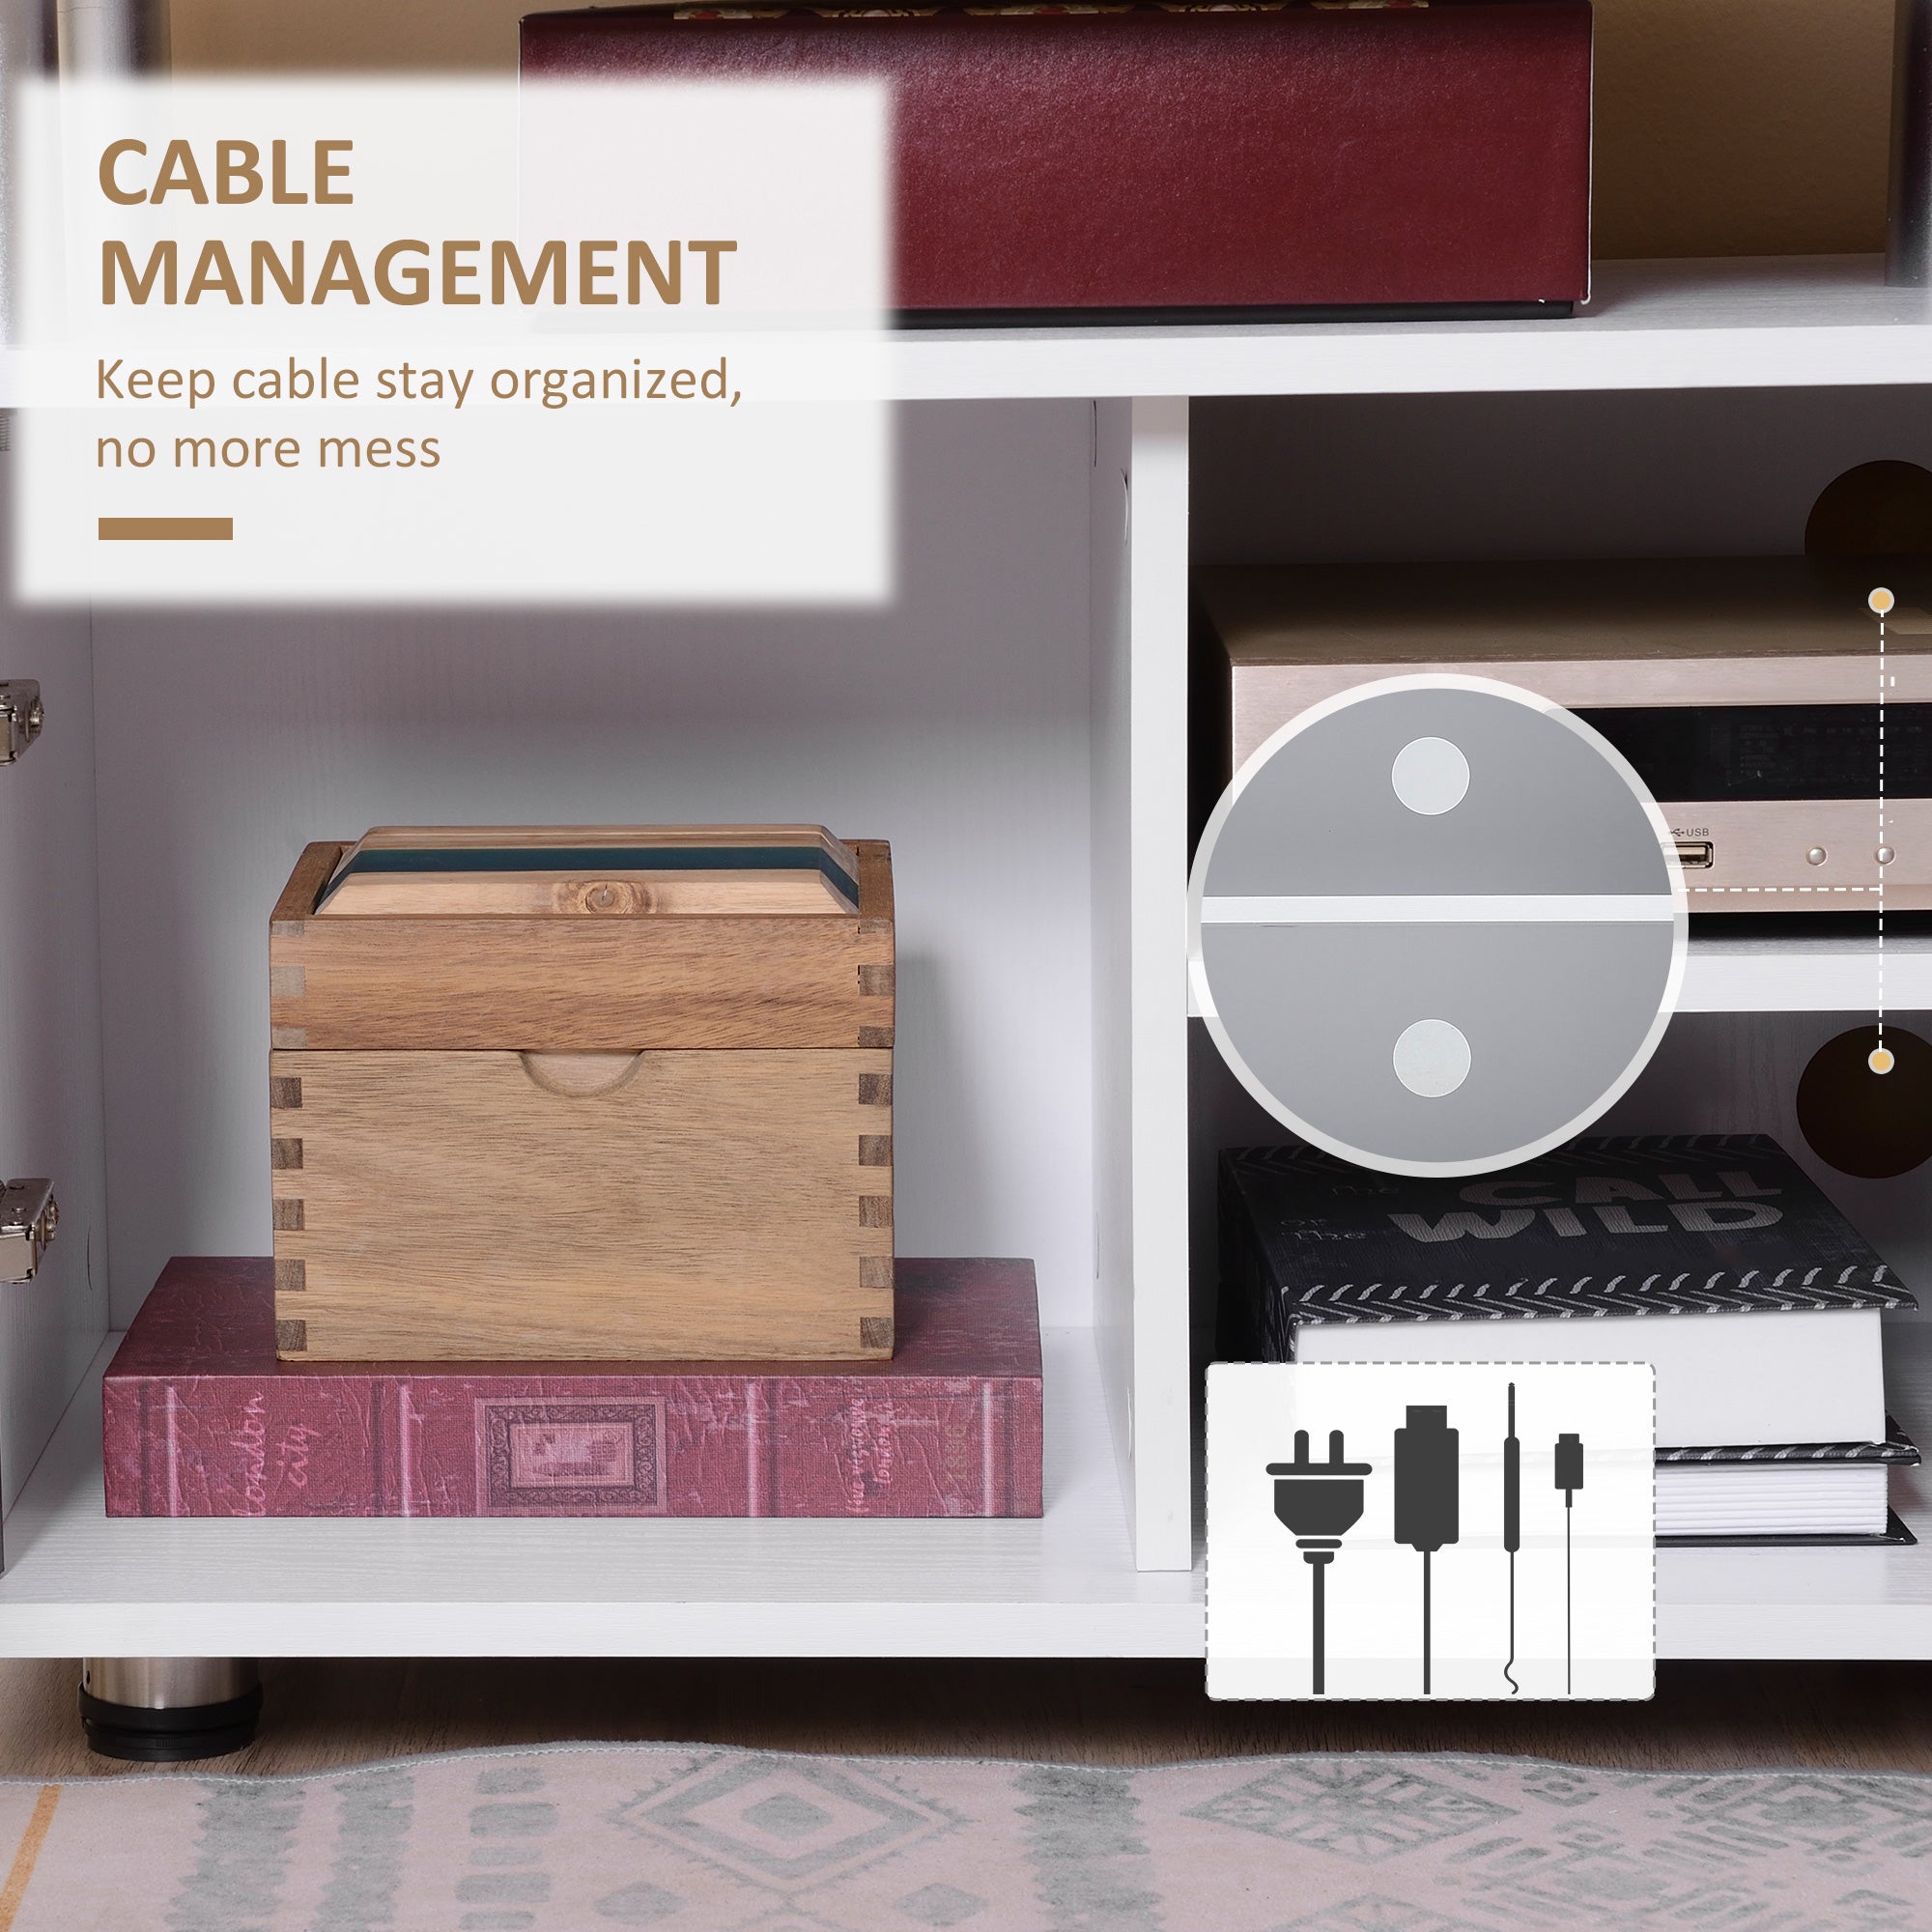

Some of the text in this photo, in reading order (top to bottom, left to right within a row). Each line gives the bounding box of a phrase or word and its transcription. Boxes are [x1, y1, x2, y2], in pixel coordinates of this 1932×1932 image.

[1686, 828, 1710, 837] USB
[1459, 1170, 1783, 1208] CALL
[1387, 1201, 1784, 1243] WILD
